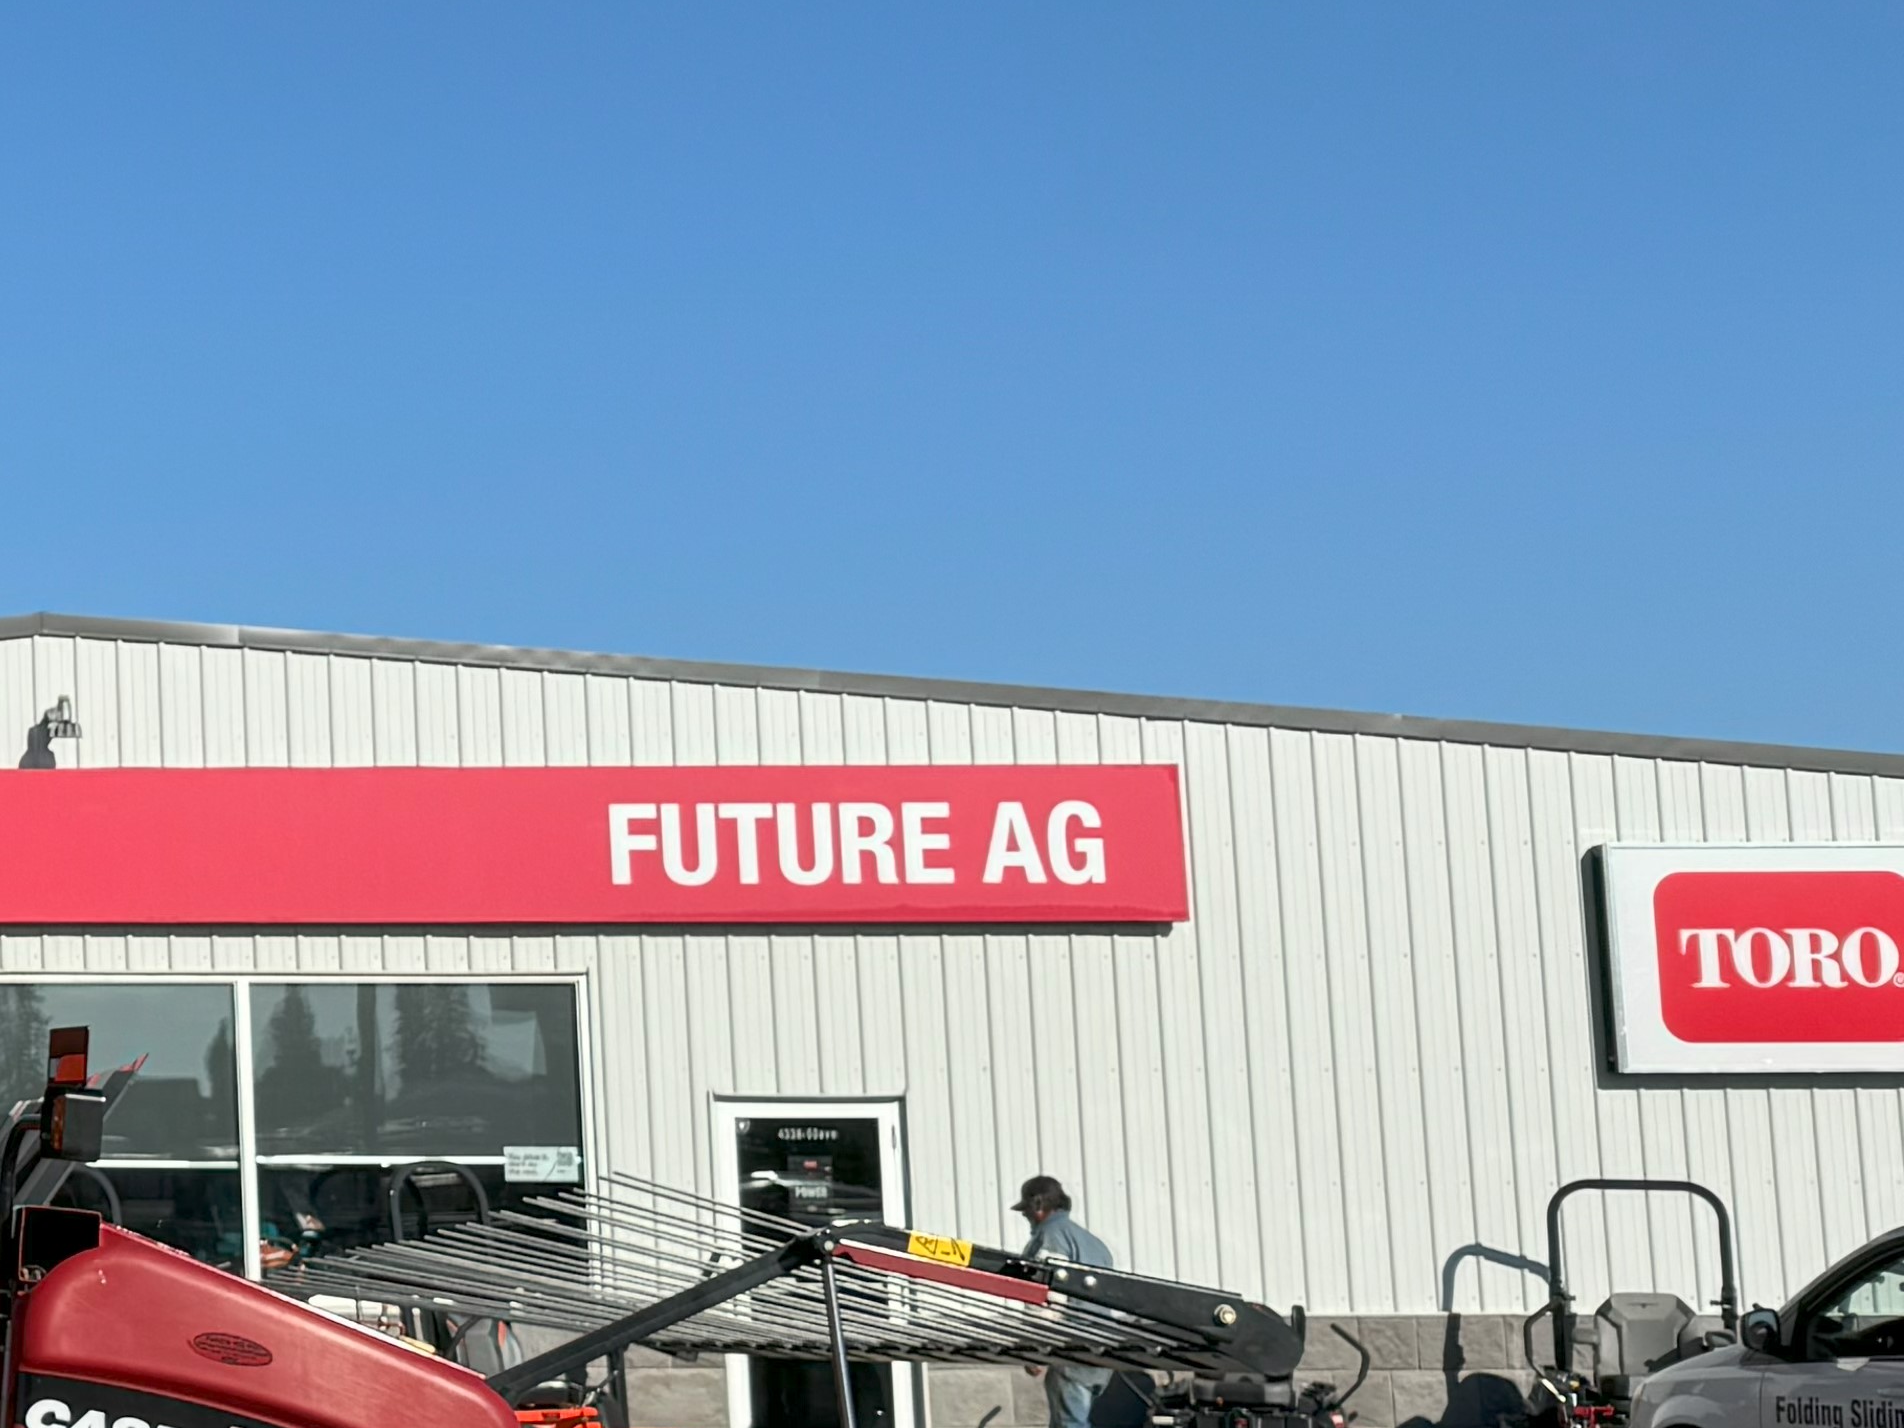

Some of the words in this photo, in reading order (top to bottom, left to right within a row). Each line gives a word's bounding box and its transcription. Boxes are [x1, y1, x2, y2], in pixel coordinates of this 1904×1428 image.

[607, 802, 955, 886] FUTURE
[982, 801, 1106, 886] AG
[1679, 926, 1900, 989] TORO
